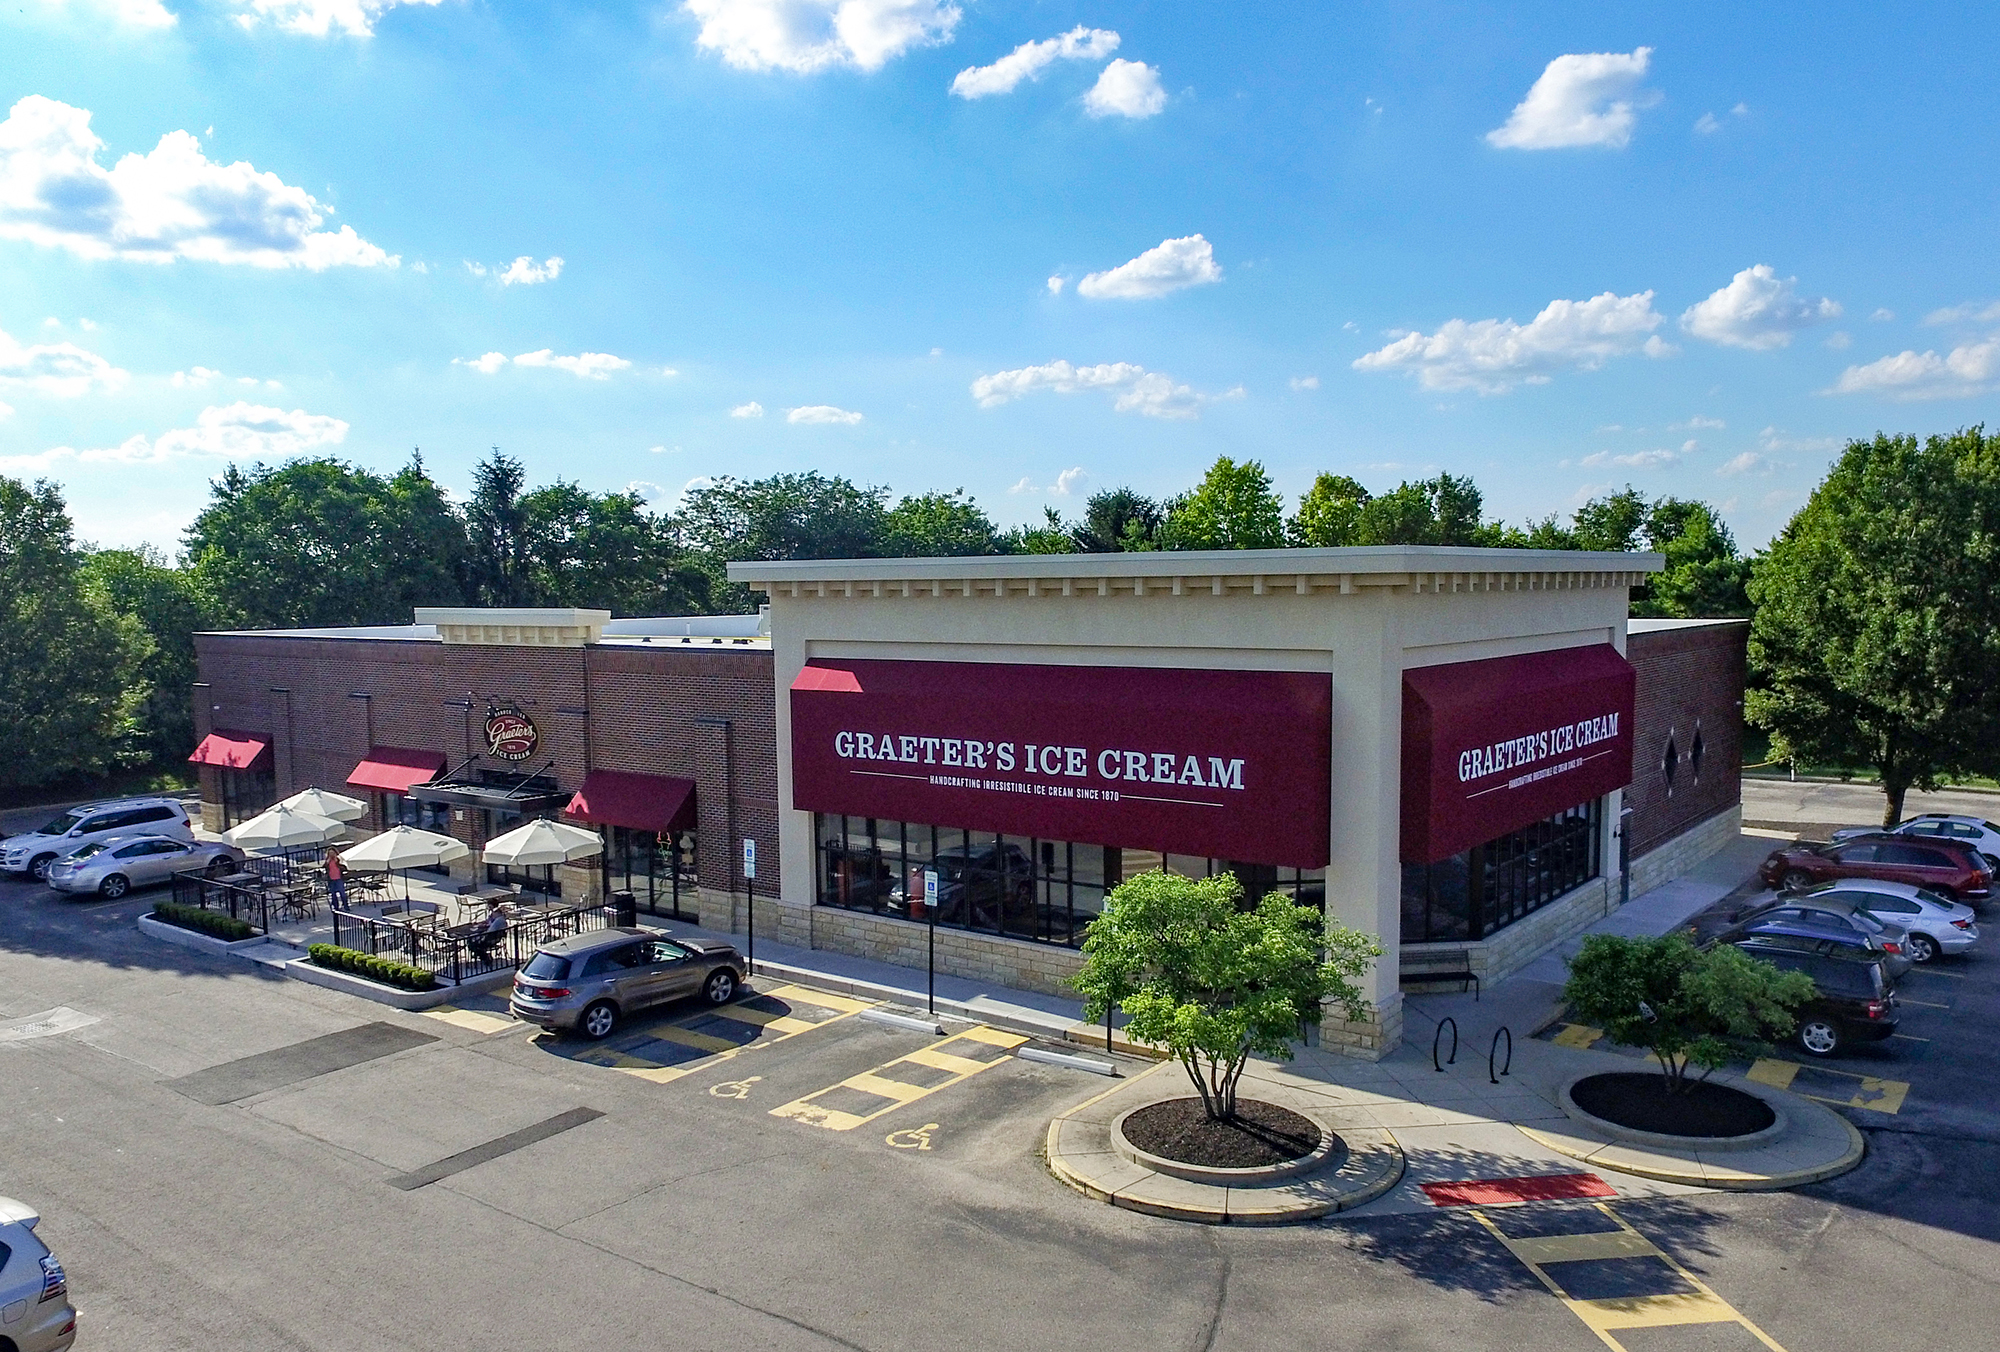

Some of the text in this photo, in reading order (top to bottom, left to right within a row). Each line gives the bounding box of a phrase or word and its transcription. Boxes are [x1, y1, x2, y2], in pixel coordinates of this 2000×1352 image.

[496, 749, 531, 760] ICE CREAM
[834, 731, 1245, 790] GRAETER'S ICE CREAM
[1458, 730, 1548, 783] GRAETER'S
[1550, 724, 1574, 756] ICE
[1575, 712, 1619, 748] CREAM
[929, 775, 1120, 802] HANDCRAFTING IRRESISTIBLE ICE CREAM SINCE 1870
